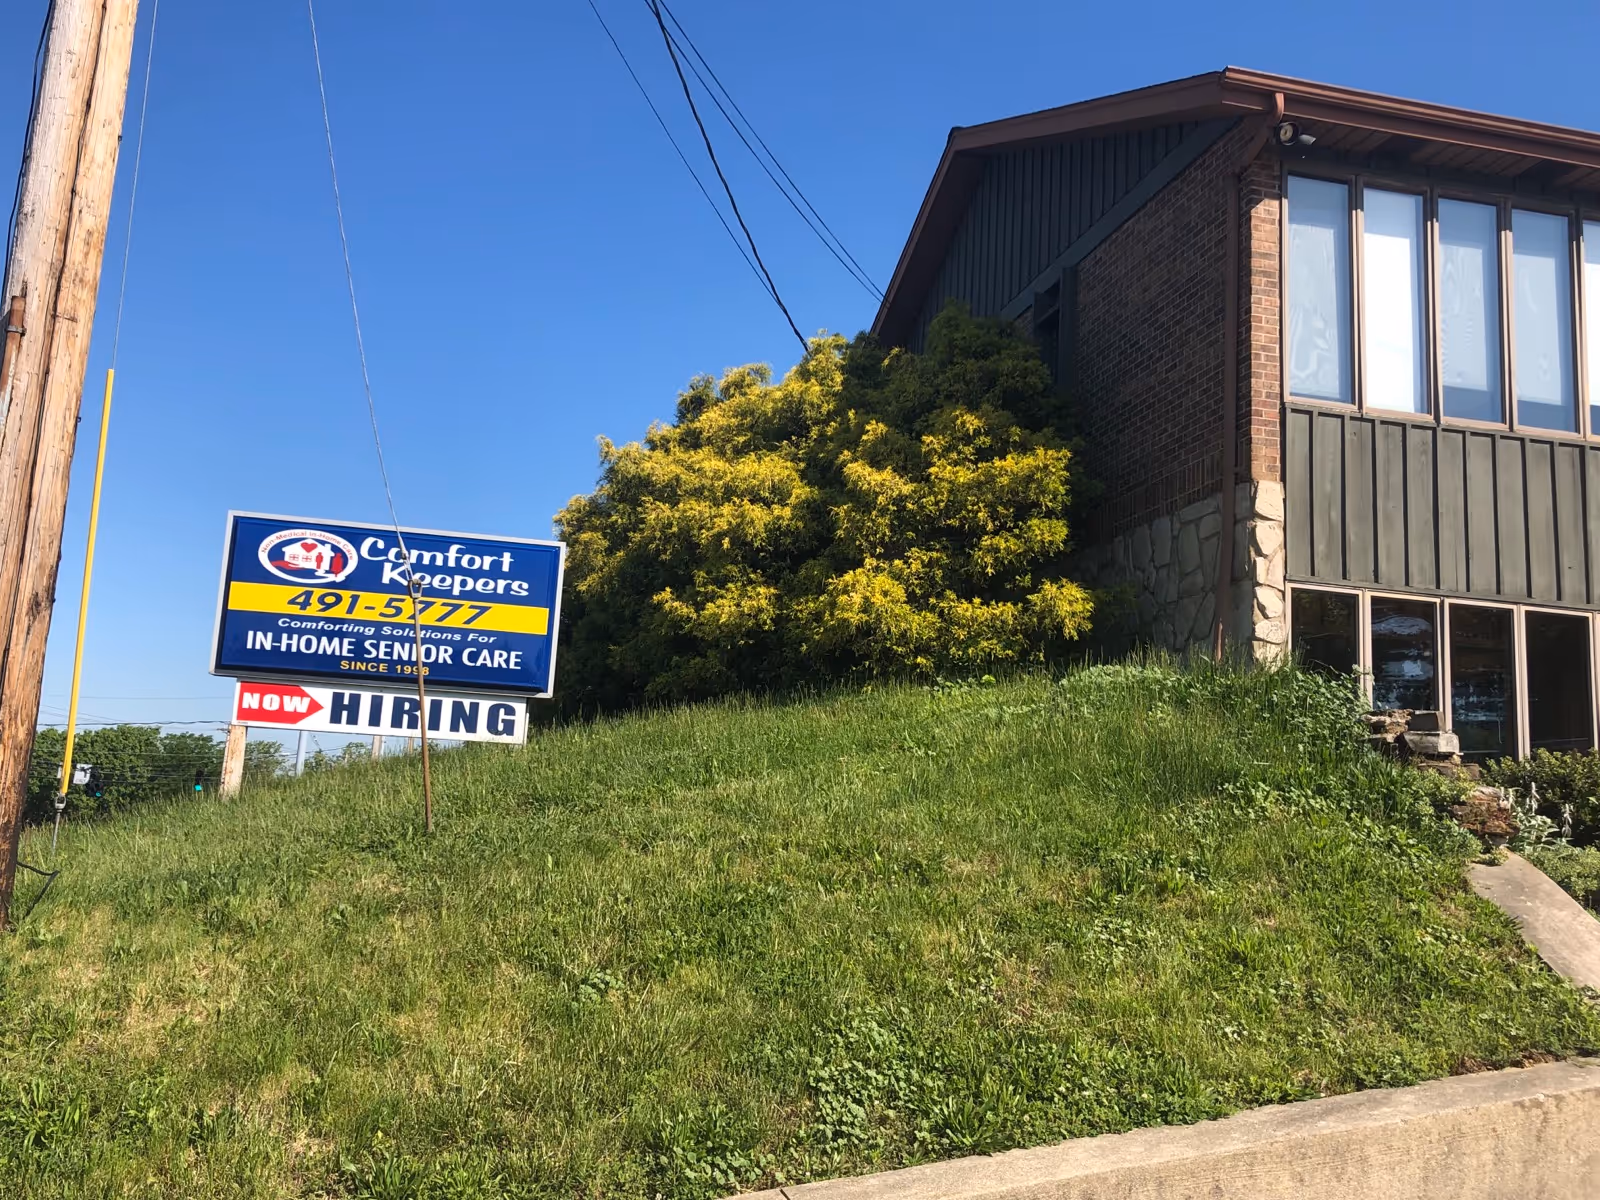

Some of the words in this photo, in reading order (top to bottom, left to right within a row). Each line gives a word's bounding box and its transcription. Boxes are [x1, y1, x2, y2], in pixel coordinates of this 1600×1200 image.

[360, 536, 514, 572] Comfort
[381, 562, 529, 596] Keepers
[287, 590, 492, 625] 491-5777
[278, 618, 375, 635] Comforting
[381, 626, 462, 641] Solutions
[467, 633, 497, 644] For
[246, 630, 356, 657] IN-HOME
[364, 640, 453, 664] SENIOR
[462, 648, 523, 670] CARE
[340, 661, 388, 673] SINCE
[395, 665, 430, 676] 1998
[242, 692, 311, 713] NOW
[329, 691, 516, 737] HIRING
